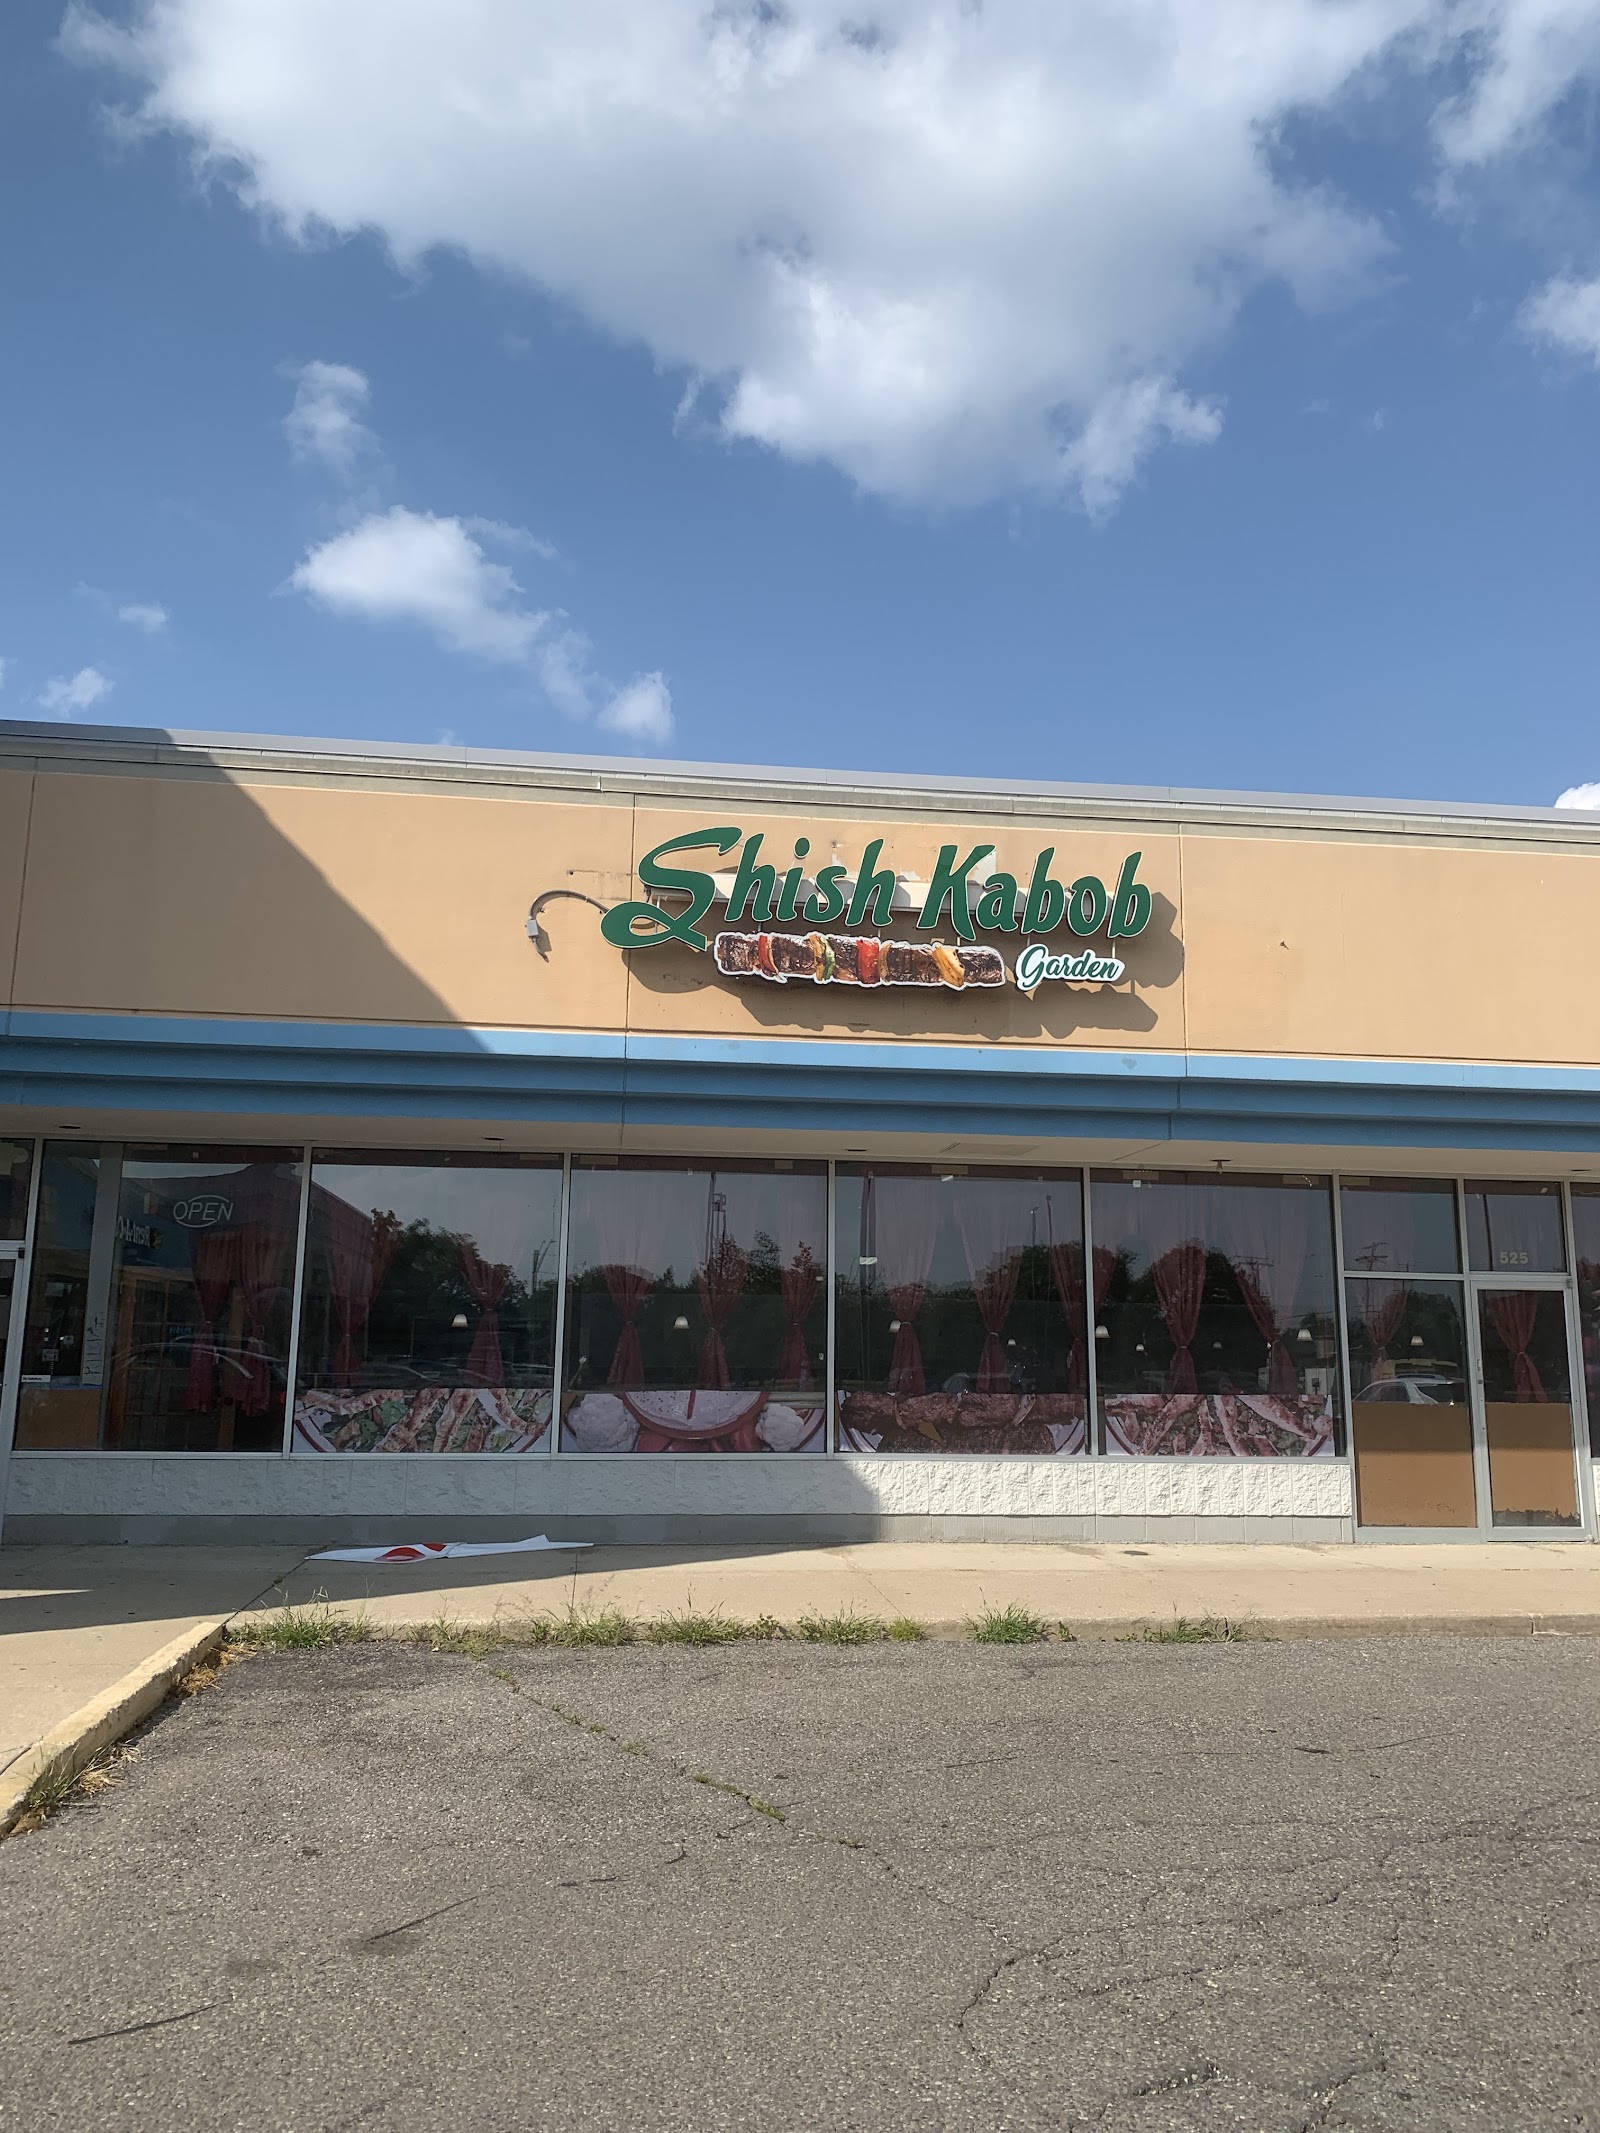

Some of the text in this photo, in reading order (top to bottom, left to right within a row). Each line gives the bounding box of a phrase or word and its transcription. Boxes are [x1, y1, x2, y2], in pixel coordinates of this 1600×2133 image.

[600, 827, 1152, 950] Shish Kabob
[1021, 945, 1120, 988] Garden
[173, 1201, 234, 1221] OPEN
[1499, 1251, 1529, 1265] 525
